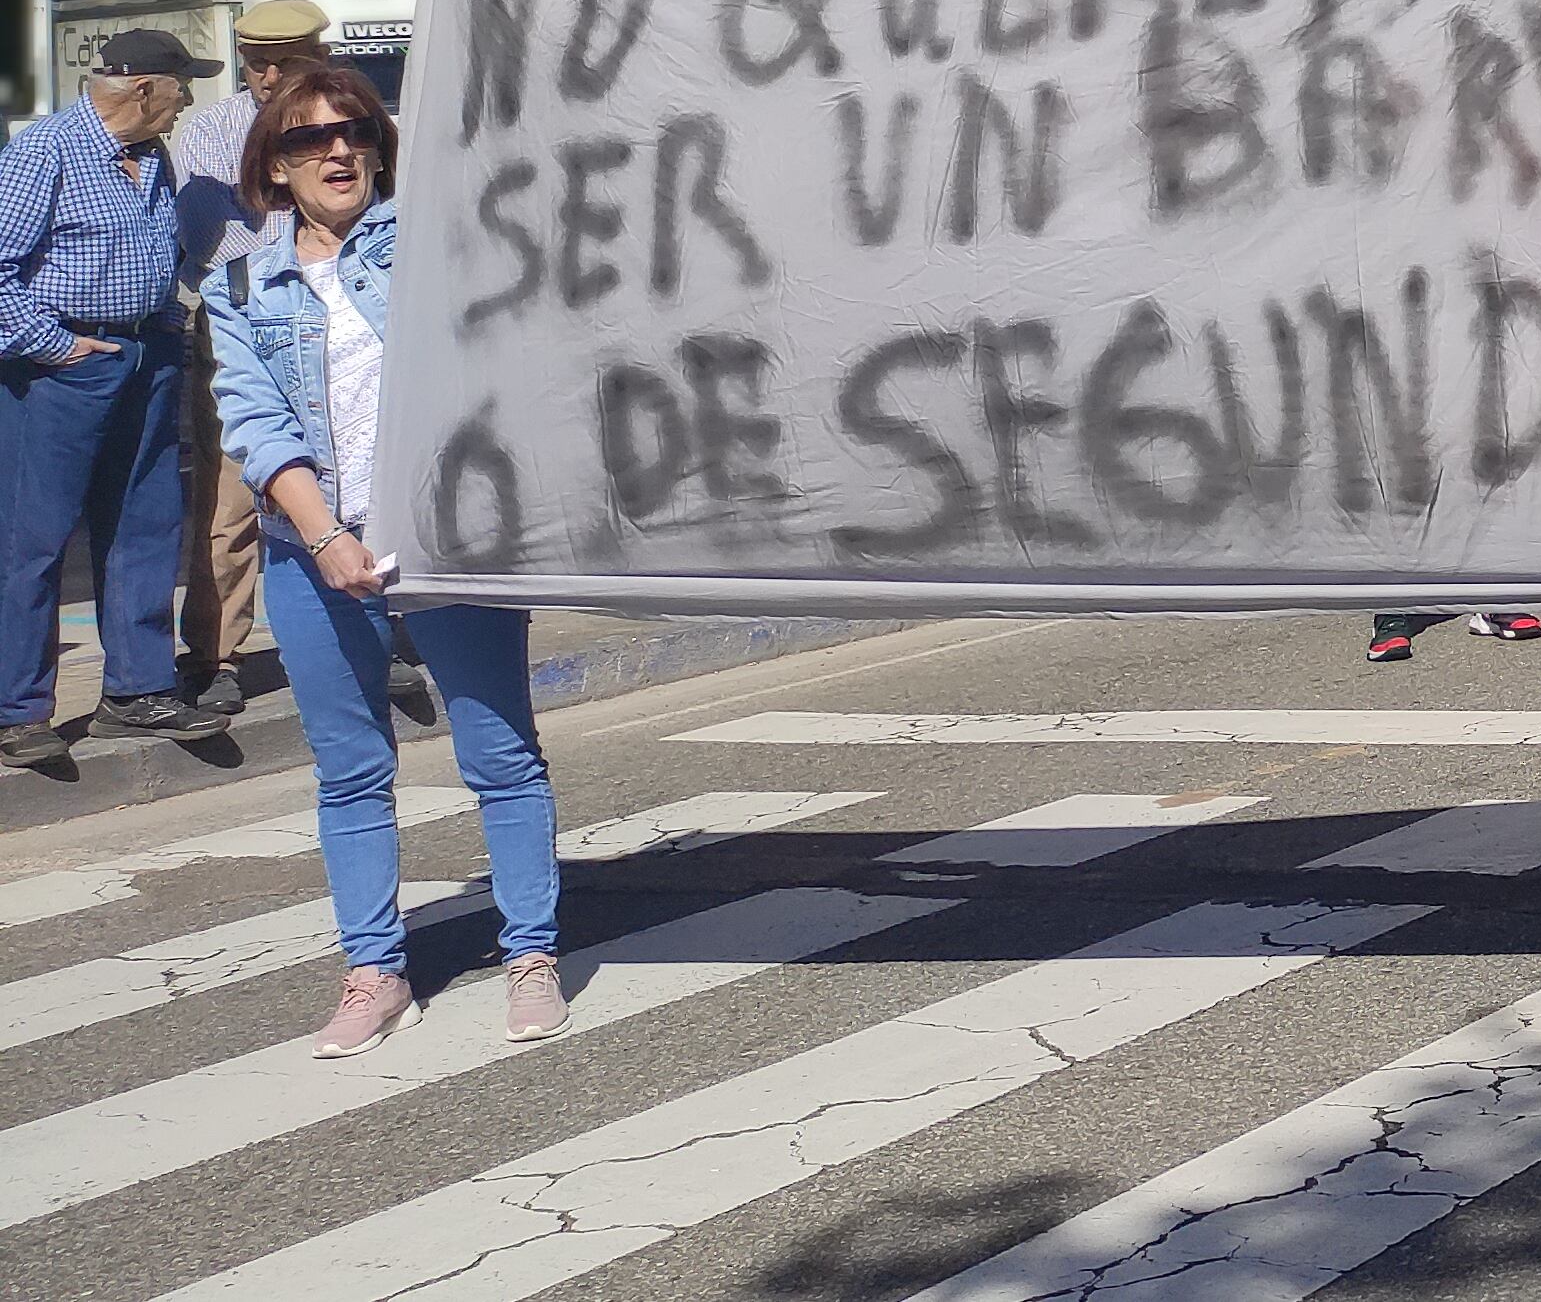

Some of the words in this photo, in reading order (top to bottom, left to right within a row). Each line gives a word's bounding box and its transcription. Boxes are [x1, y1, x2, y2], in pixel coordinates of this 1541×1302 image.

[328, 42, 394, 56] arbón
[345, 23, 413, 38] IVECO
[458, 109, 775, 335] SER
[831, 75, 1072, 248] UN
[597, 330, 788, 522] DE
